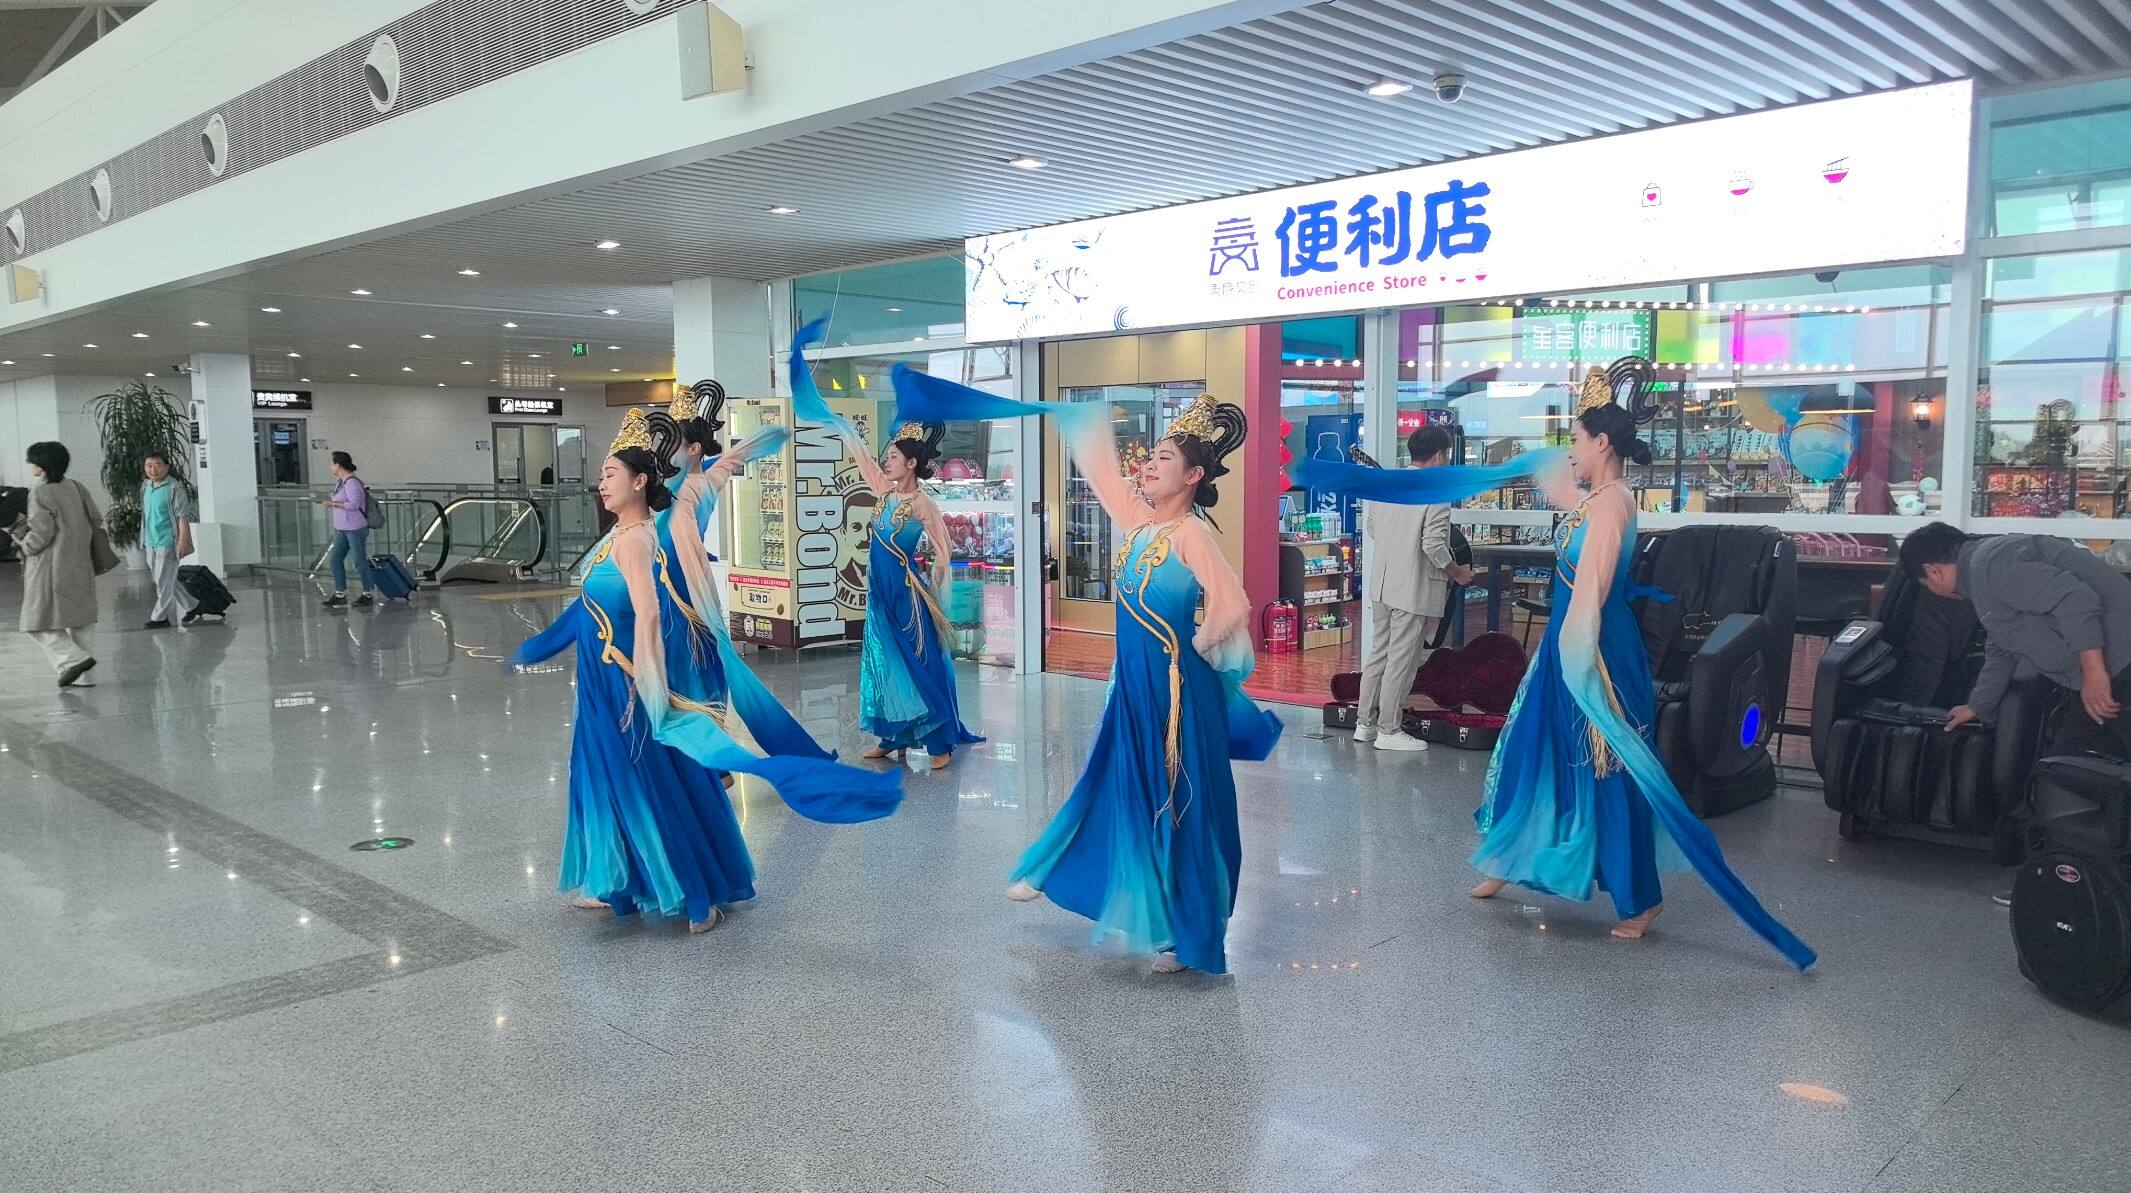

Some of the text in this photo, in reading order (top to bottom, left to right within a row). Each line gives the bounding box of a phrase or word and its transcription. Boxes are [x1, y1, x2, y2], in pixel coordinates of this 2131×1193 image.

[1275, 178, 1492, 278] 便利店
[1277, 273, 1427, 300] Convenience Store
